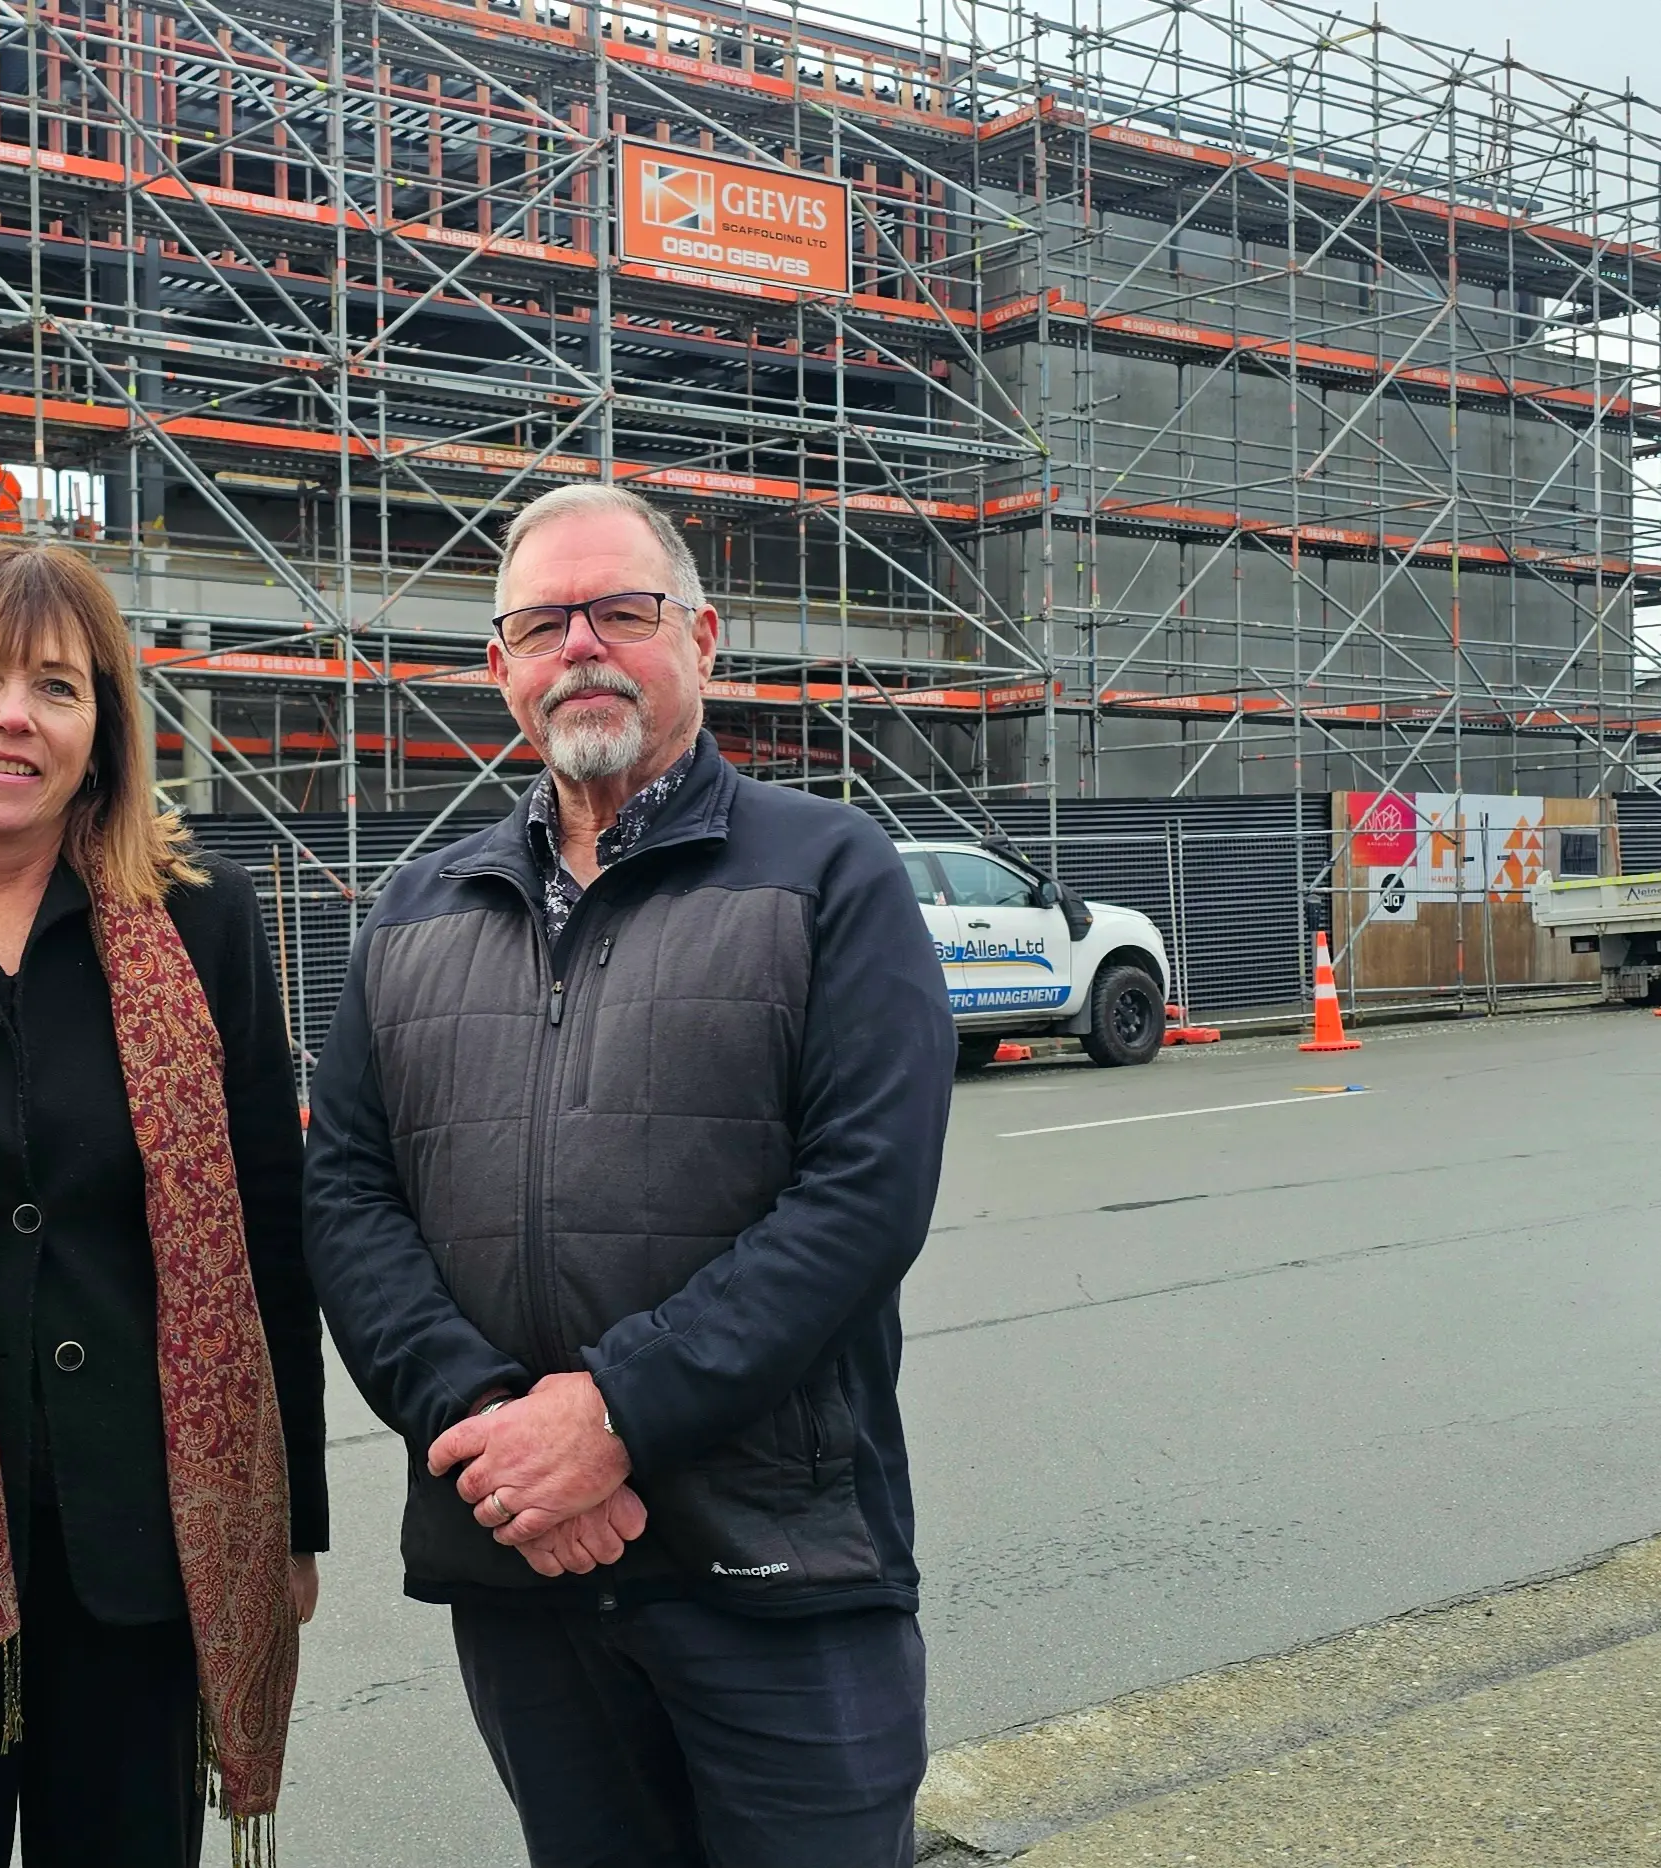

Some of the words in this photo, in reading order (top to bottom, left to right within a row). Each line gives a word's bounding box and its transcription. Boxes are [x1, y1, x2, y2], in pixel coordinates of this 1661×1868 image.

[251, 194, 318, 218] GEEVES
[721, 182, 827, 231] GEEVES
[721, 222, 803, 245] SCAFFOLDING
[807, 237, 828, 249] LTD
[662, 236, 724, 262] 0800
[727, 248, 810, 277] GEEVES
[995, 298, 1038, 322] GEEVE
[704, 476, 755, 490] GEEVES
[999, 491, 1041, 509] GEEVE
[262, 659, 326, 672] GEEVES
[992, 686, 1044, 702] GEEVES
[964, 940, 1008, 957] Allen
[1015, 937, 1045, 955] Ltd
[977, 988, 1062, 1006] MANAGEMENT
[728, 1562, 790, 1577] macpac
